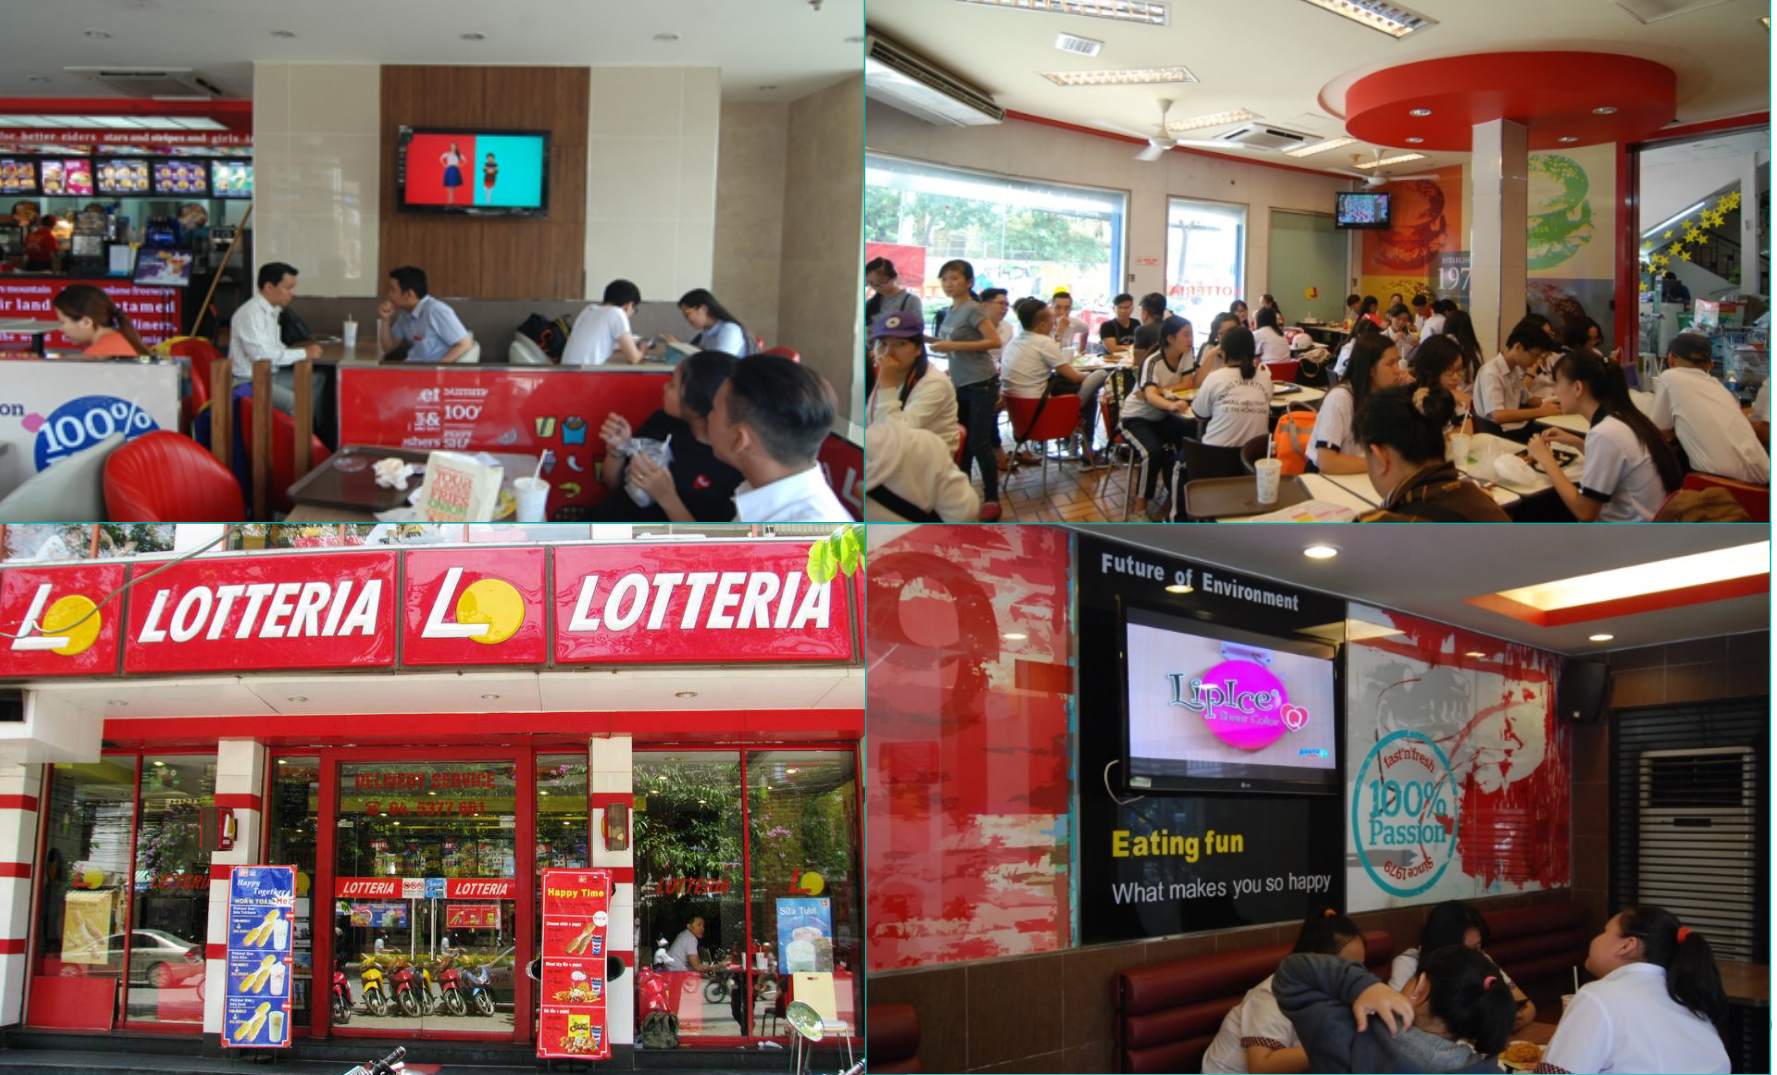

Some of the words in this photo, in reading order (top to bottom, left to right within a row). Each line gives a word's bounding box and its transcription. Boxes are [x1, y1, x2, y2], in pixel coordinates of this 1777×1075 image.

[21, 131, 55, 141] better
[61, 132, 96, 141] riders
[103, 134, 129, 142] stars
[131, 134, 149, 142] and
[150, 134, 185, 144] stripes
[187, 134, 207, 142] and
[211, 134, 239, 144] girls
[16, 298, 51, 312] land
[118, 300, 176, 313] tamed
[38, 400, 151, 453] 100%
[1101, 553, 1165, 582] Future
[1175, 568, 1194, 587] of
[1202, 572, 1299, 612] Environment
[138, 580, 382, 643] LOTTERIA
[568, 571, 831, 632] LOTTERIA
[354, 771, 425, 790] DELIVERY
[431, 770, 496, 789] SERVICE
[1369, 778, 1447, 818] 100%
[1369, 819, 1447, 846] Passion
[1112, 829, 1199, 863] Eating
[1204, 829, 1244, 855] fun
[1384, 860, 1406, 881] 1979
[237, 879, 261, 888] Happy
[343, 881, 395, 894] LOTTERIA
[455, 883, 508, 896] LOTTERIA
[547, 887, 578, 899] Happy
[581, 888, 605, 897] Time
[1112, 880, 1165, 905] What
[1169, 877, 1227, 900] makes
[1232, 878, 1263, 900] you
[1265, 875, 1285, 891] so
[1288, 872, 1332, 893] happy
